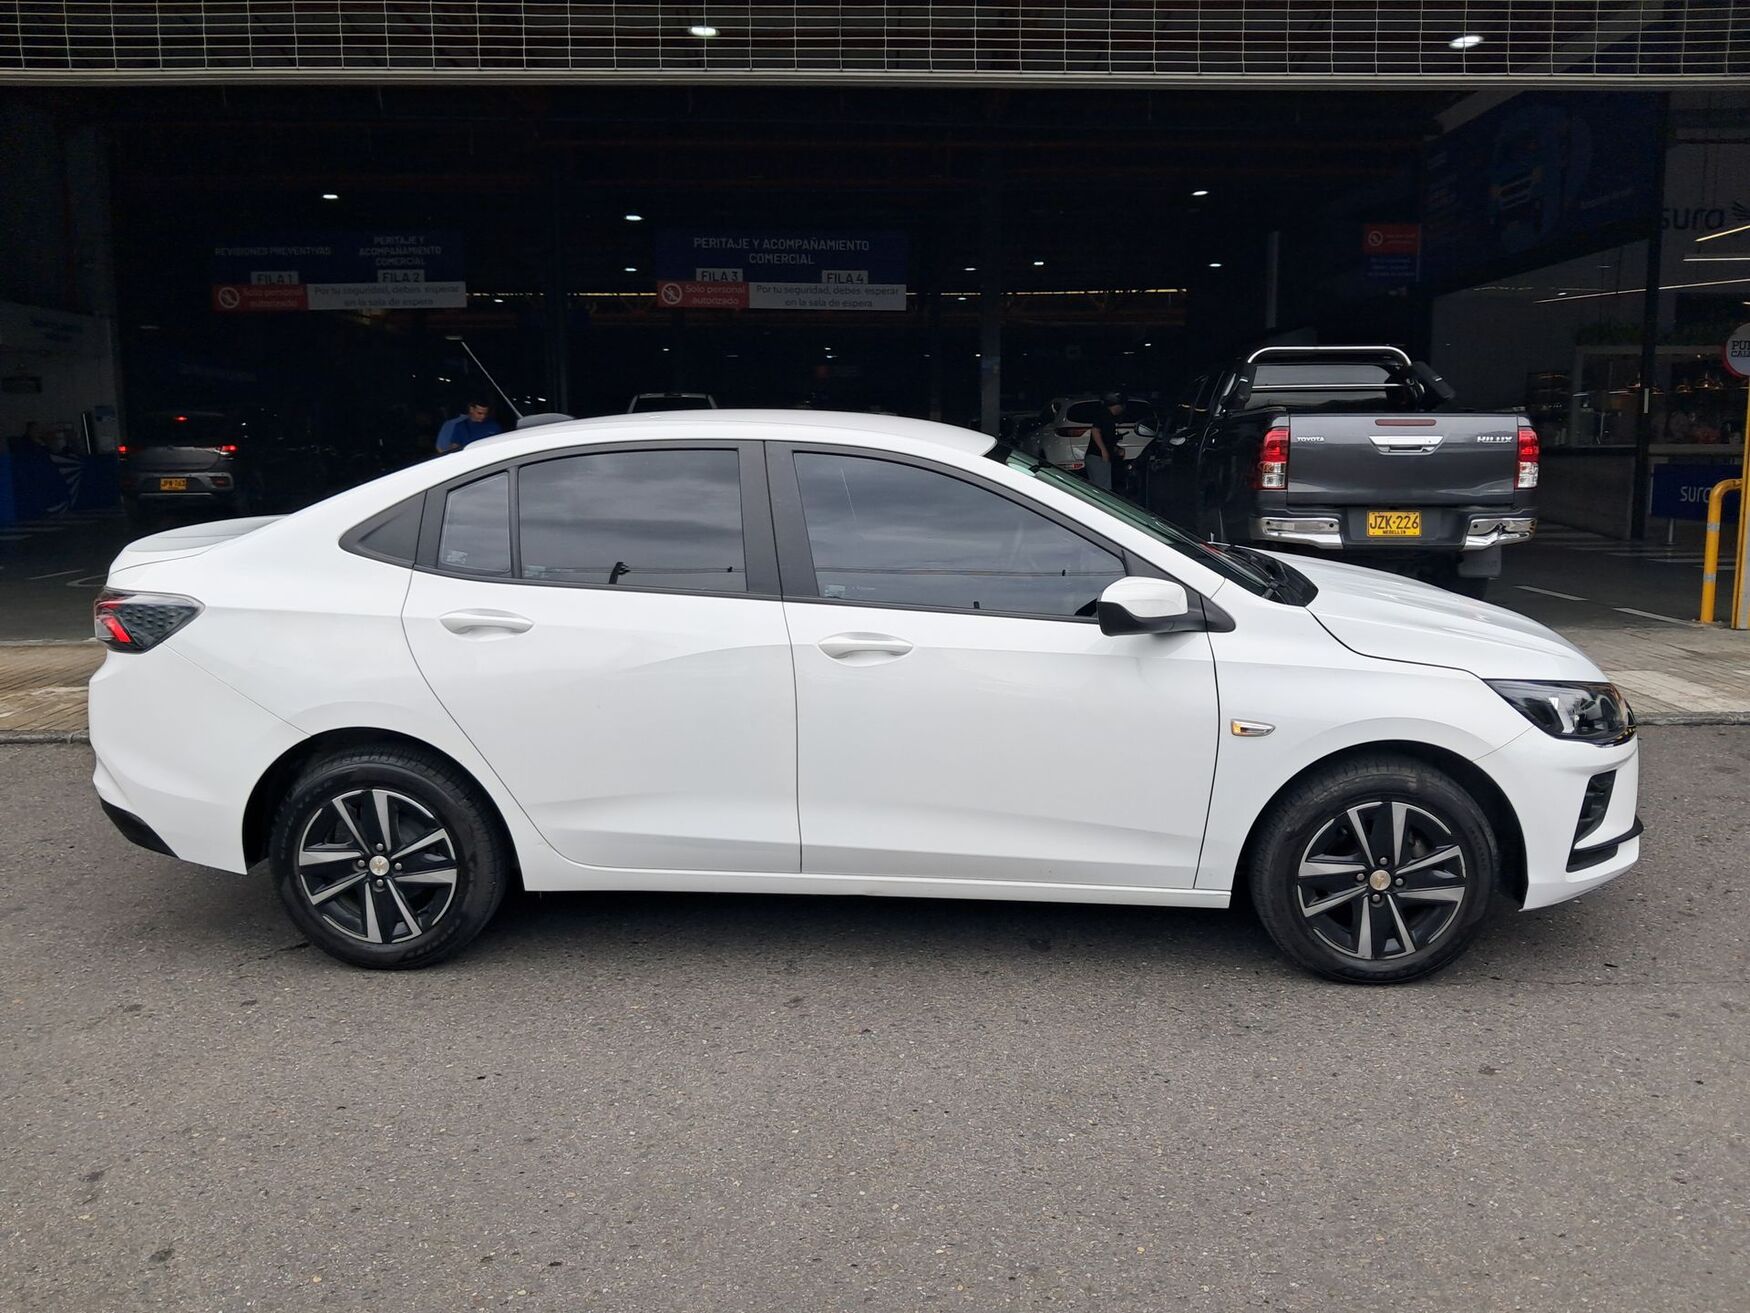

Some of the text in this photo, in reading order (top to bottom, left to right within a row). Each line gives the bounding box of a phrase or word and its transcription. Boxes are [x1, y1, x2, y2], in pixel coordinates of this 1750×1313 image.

[693, 237, 870, 251] PERITAJE Y ACOMPAÑAMIENTO
[749, 252, 815, 265] COMERCIAL
[255, 273, 285, 285] FILA
[382, 271, 420, 283] FILA 2
[701, 271, 738, 281] FILA 3
[826, 272, 864, 284] FILA 4
[685, 284, 706, 293] Solo
[756, 284, 772, 294] Por
[1476, 435, 1513, 444] HILUX
